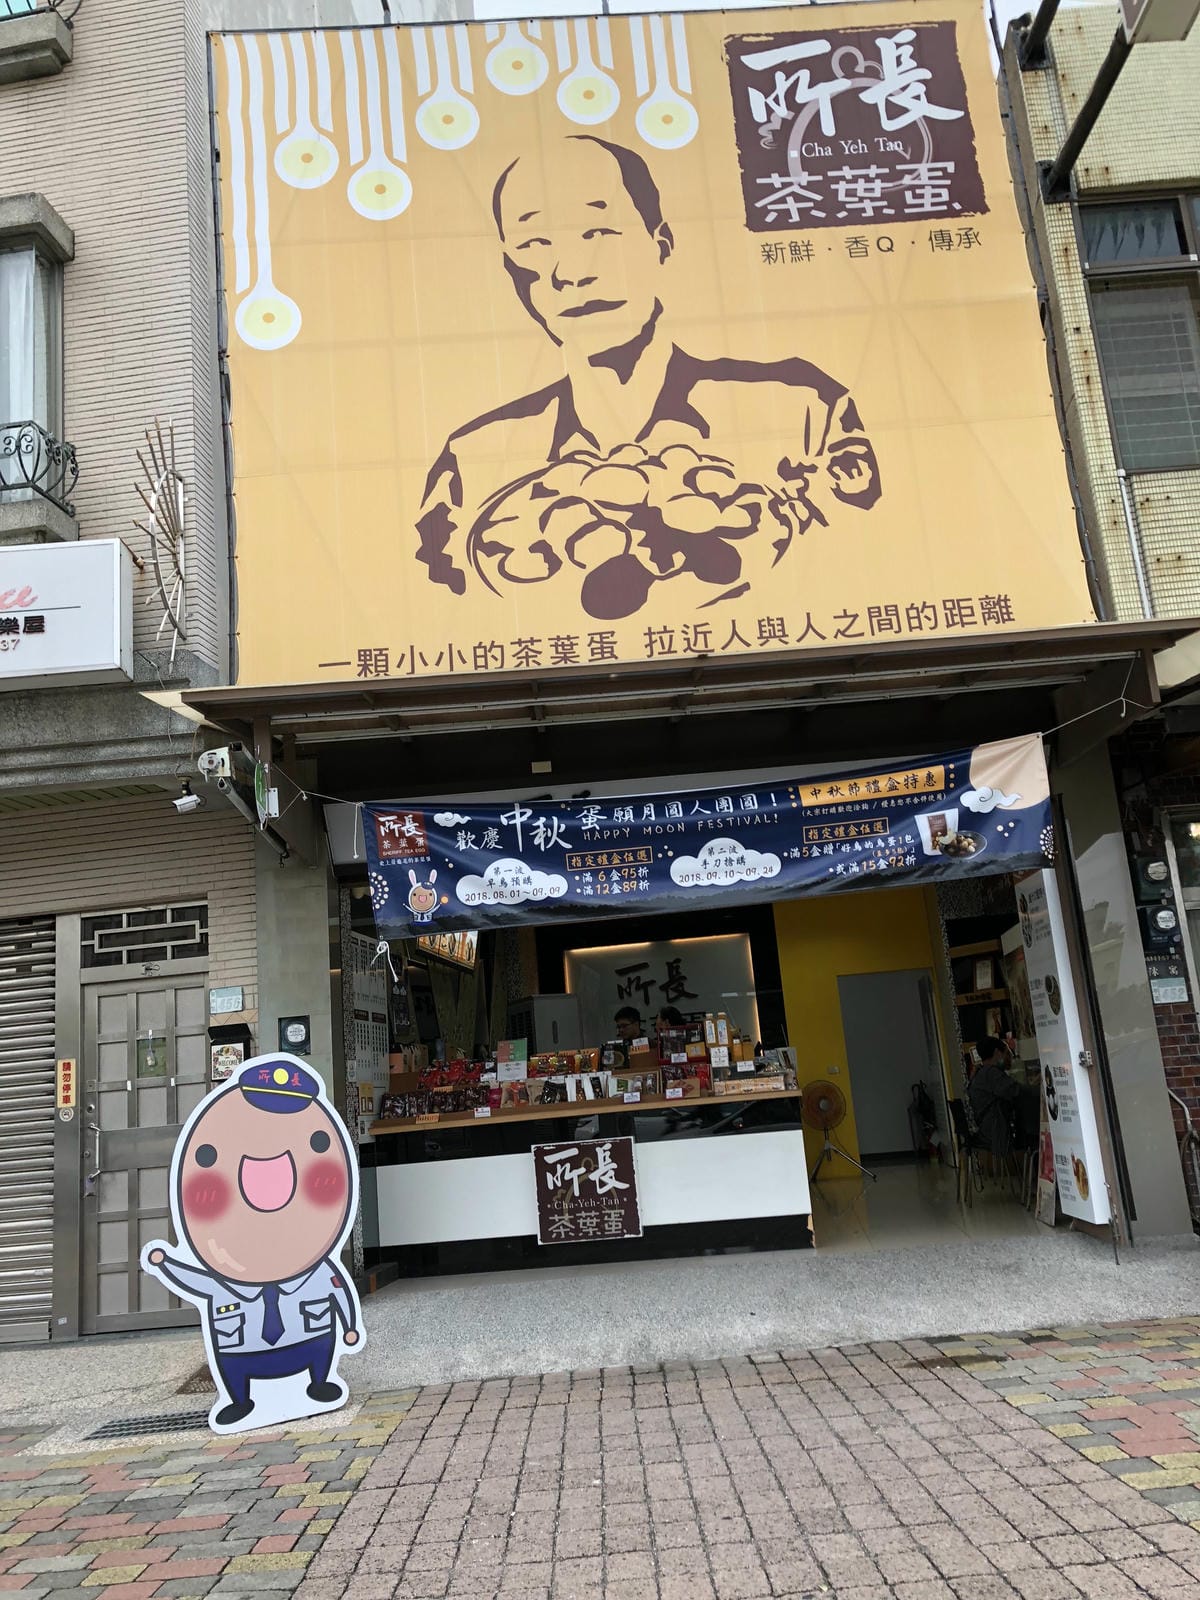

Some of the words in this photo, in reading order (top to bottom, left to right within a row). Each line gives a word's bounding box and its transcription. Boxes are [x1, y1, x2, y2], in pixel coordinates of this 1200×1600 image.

[740, 29, 965, 136] 所長
[802, 142, 832, 158] Cha
[839, 139, 868, 154] Yeh
[875, 137, 904, 152] Tan
[754, 161, 962, 222] 茶葉蛋
[318, 630, 619, 678] 一顆小小的茶葉蛋
[643, 594, 1015, 659] 拉近人與人之間的距離
[810, 770, 937, 800] 中秋節禮盒特惠
[378, 814, 424, 837] 所長
[583, 827, 630, 841] HAPPY
[643, 822, 685, 836] MOON
[697, 813, 778, 832] FESTIVAL!
[707, 845, 739, 857] 第二波
[493, 865, 526, 876] 第一波
[615, 958, 698, 1006] 所長
[62, 1062, 72, 1105] 請勿停車
[544, 1142, 630, 1197] 所長
[548, 1209, 627, 1239] 茶葉蛋
